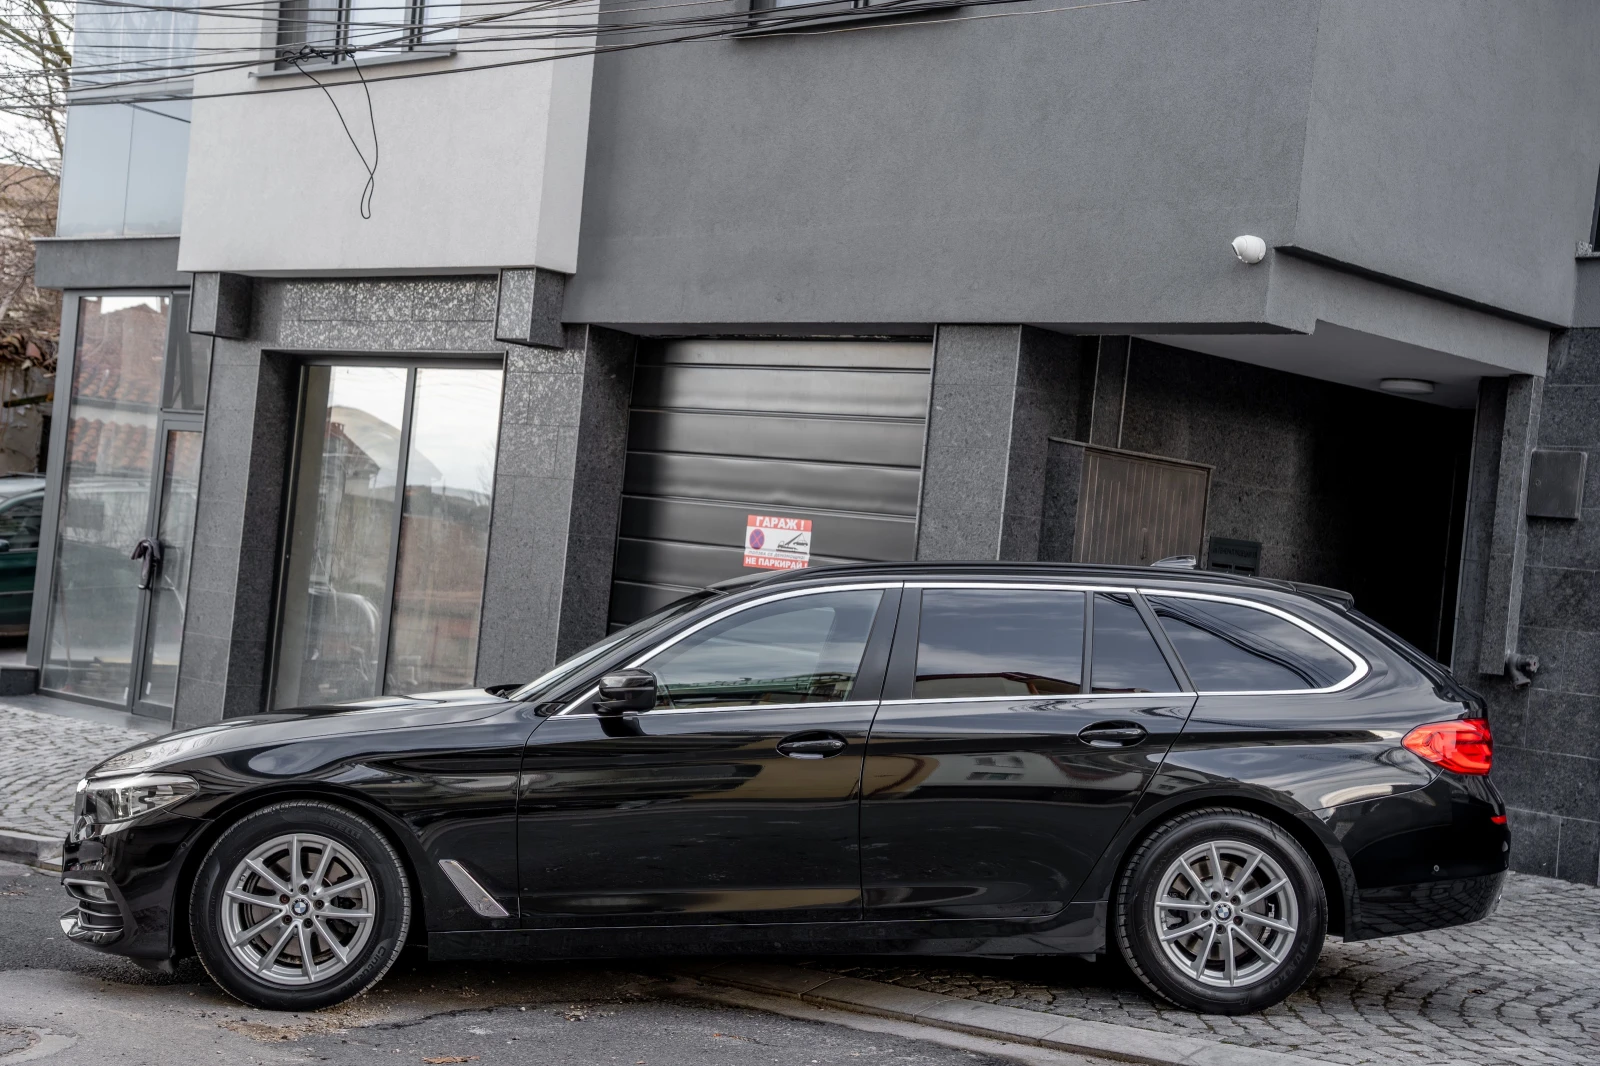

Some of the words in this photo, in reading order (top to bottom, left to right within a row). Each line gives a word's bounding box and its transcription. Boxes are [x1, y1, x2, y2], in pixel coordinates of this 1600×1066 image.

[755, 516, 798, 530] ГАРАЖ
[745, 557, 757, 565] НЕ
[758, 557, 801, 569] ПАРКИРАЙ
